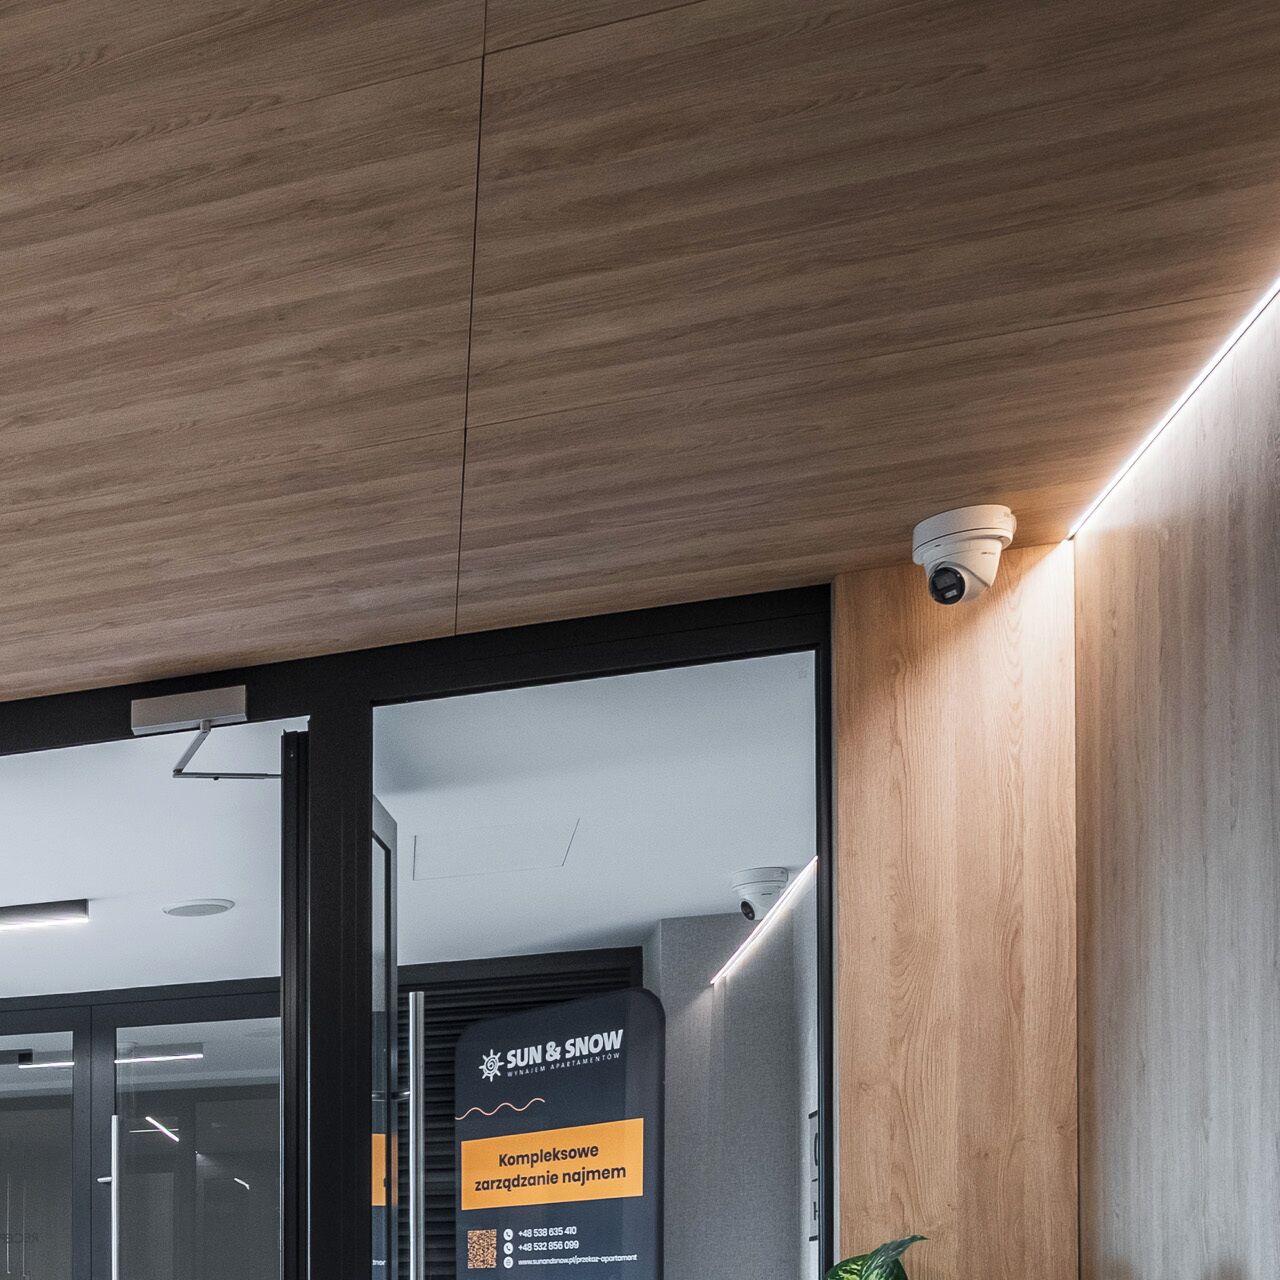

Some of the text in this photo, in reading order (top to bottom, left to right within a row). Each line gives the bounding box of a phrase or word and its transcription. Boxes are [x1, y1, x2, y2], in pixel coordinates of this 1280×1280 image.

[506, 1029, 624, 1069] SUN & SNOW
[507, 1052, 621, 1078] WYNAJEM APARTAMENTÓW
[498, 1143, 600, 1168] Kompleksowe
[474, 1165, 627, 1192] zarządzanie najmem
[518, 1229, 533, 1238] +48
[518, 1243, 533, 1252] +48
[533, 1242, 548, 1251] 532
